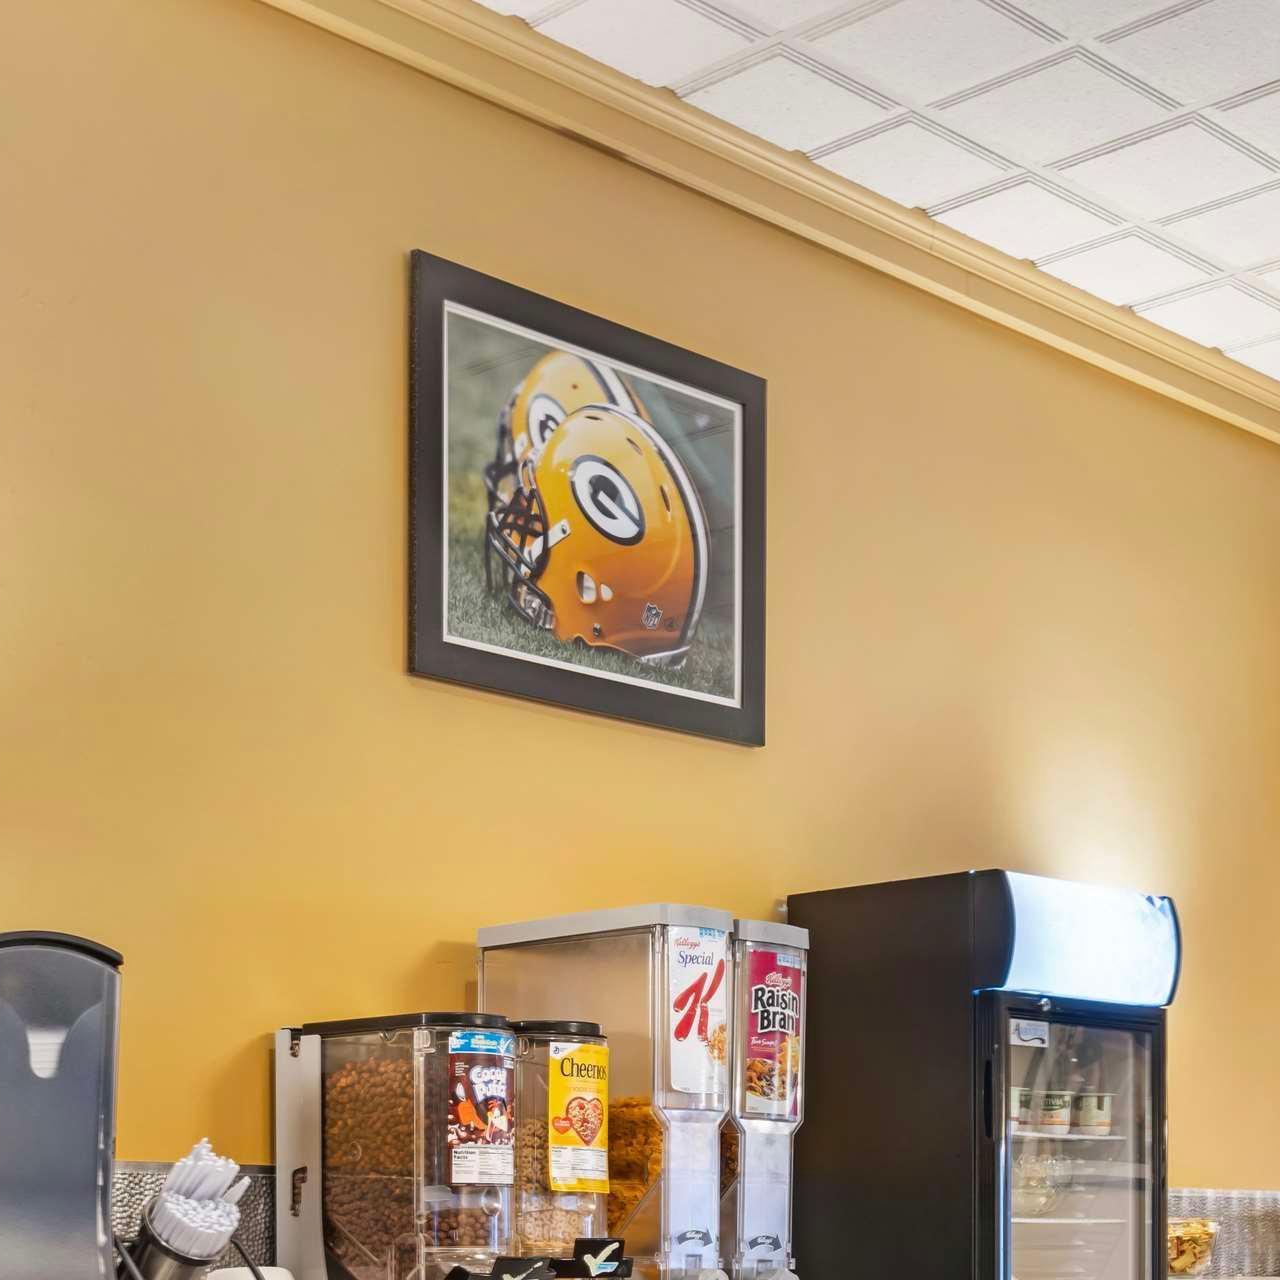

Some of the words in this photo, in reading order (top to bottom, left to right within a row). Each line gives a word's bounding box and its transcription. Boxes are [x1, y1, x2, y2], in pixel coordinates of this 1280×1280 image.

[678, 950, 714, 967] Special
[673, 959, 725, 1041] K
[753, 986, 799, 1017] Raisin
[758, 1009, 795, 1033] Bran
